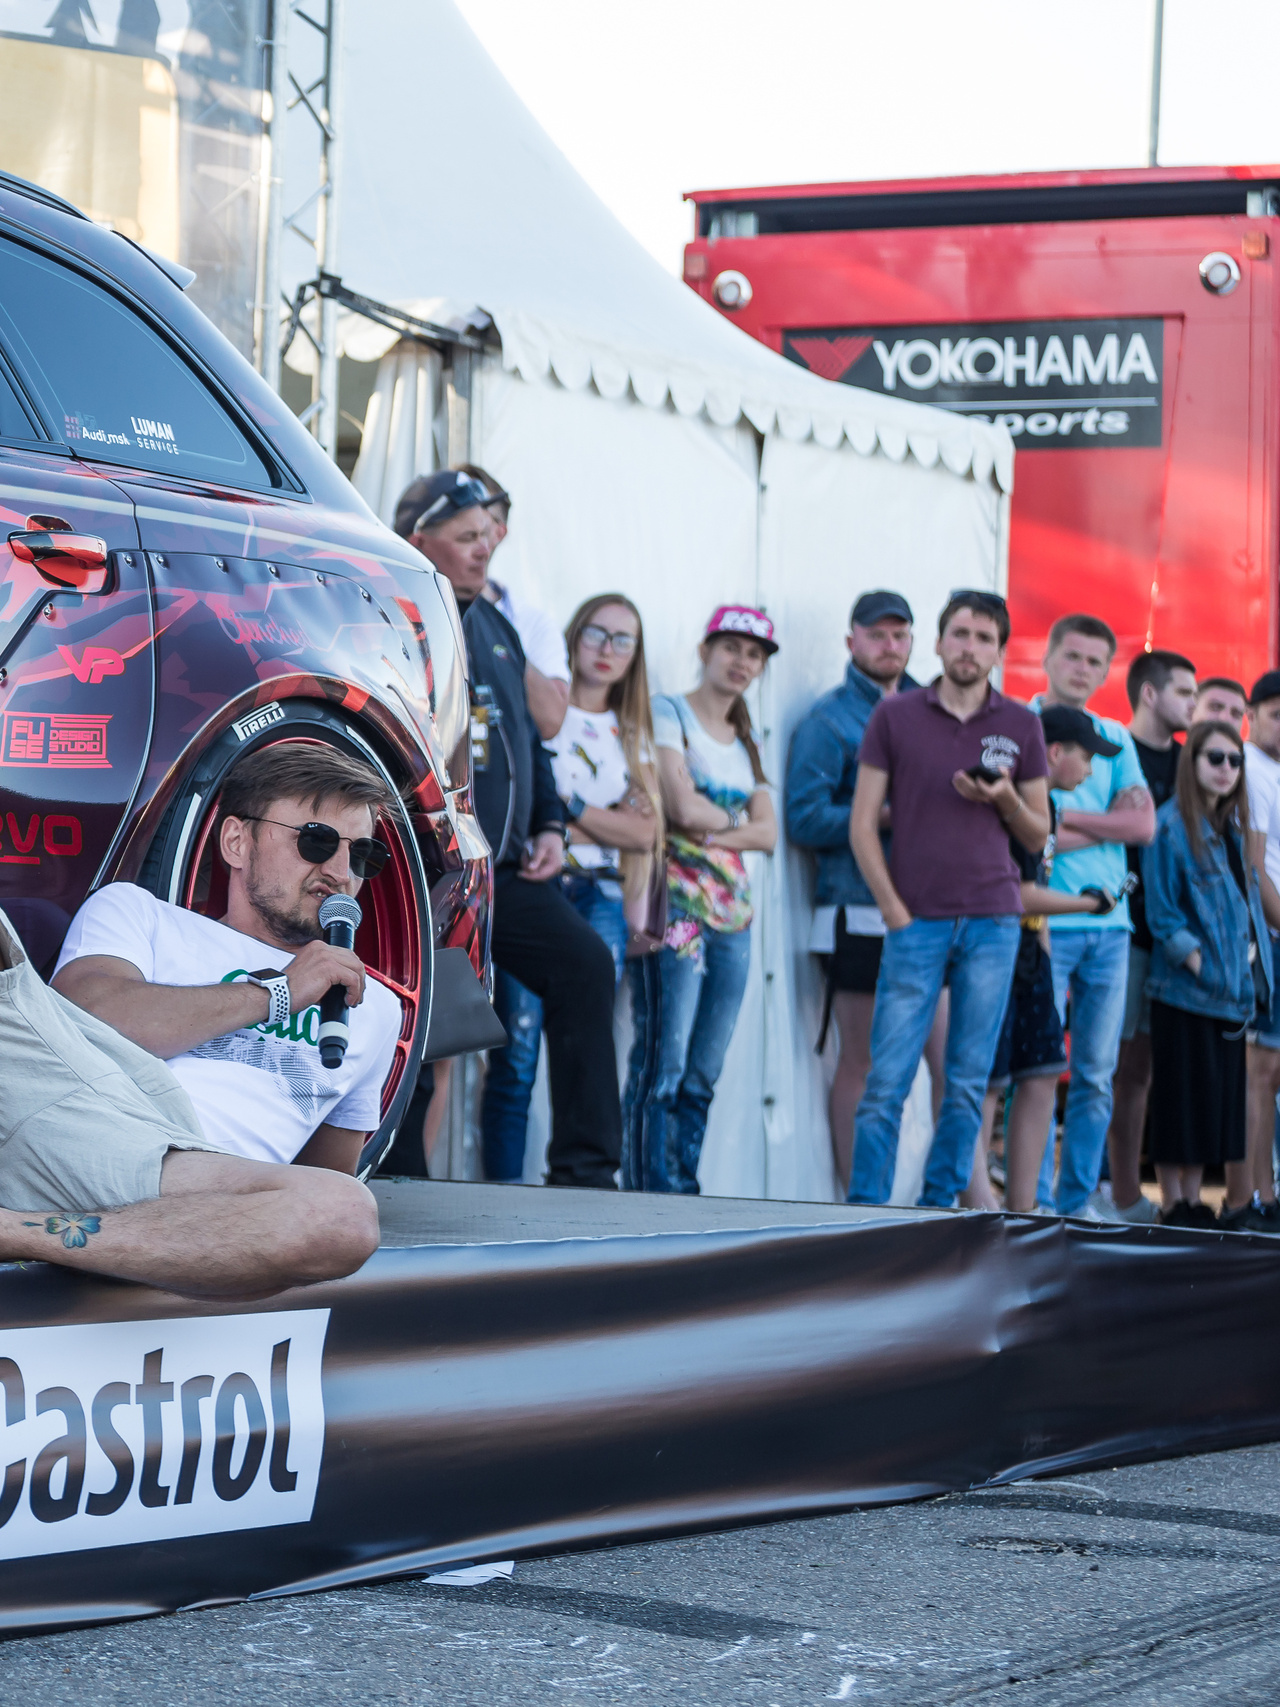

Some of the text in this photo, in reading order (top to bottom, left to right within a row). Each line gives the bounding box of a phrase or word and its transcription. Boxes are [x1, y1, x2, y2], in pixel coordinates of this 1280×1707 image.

[873, 332, 1158, 390] YOKOHAMA
[130, 416, 175, 441] LUMAN
[967, 406, 1131, 437] ports
[136, 437, 180, 455] SERVICE
[55, 644, 125, 684] VP
[49, 729, 100, 741] DESIGN
[231, 701, 286, 742] PIRELLI
[48, 741, 100, 752] STUDIO
